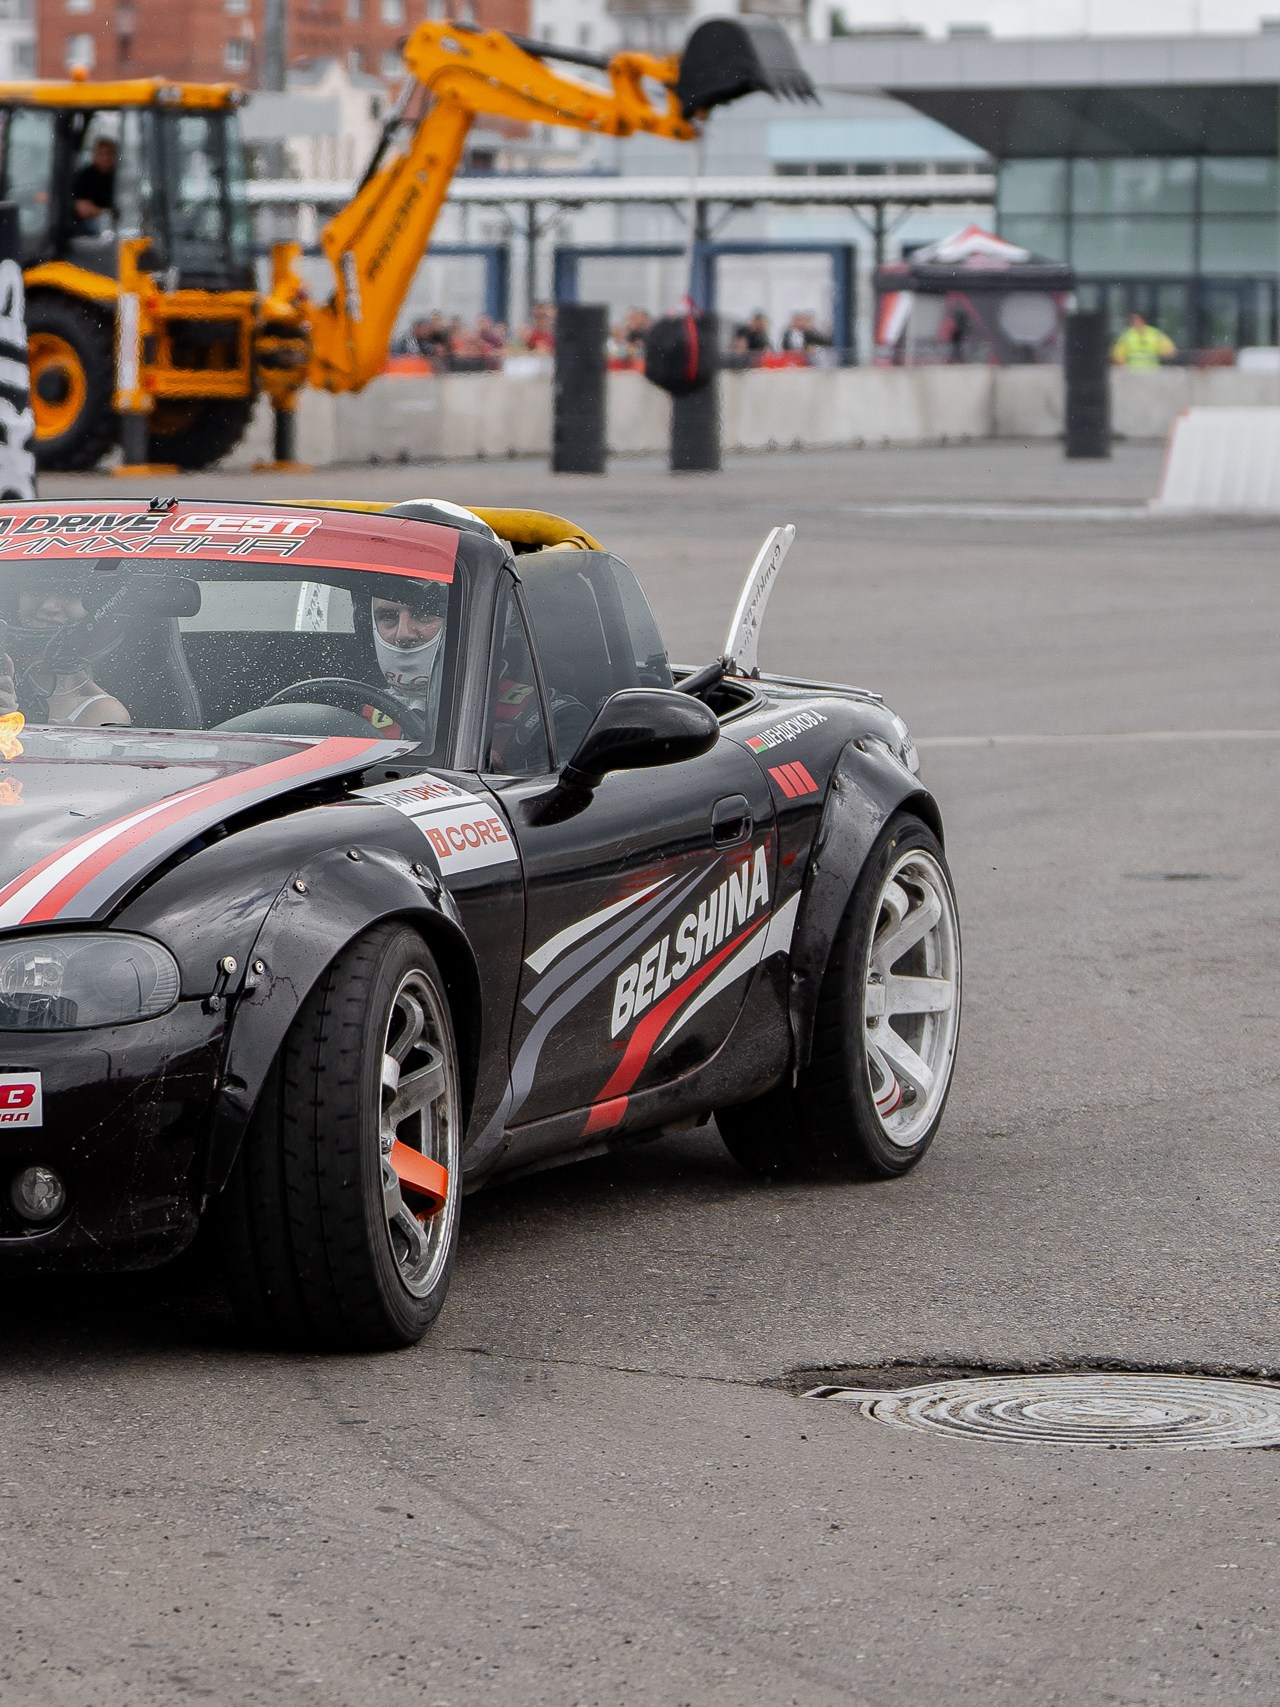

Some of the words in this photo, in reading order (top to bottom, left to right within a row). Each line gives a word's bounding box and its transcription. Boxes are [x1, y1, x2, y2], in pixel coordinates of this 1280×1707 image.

[20, 512, 173, 536] DRIVE
[174, 513, 314, 535] FEST
[756, 712, 819, 749] ШЕНДЮКОВ
[611, 844, 770, 1039] BELSHINA
